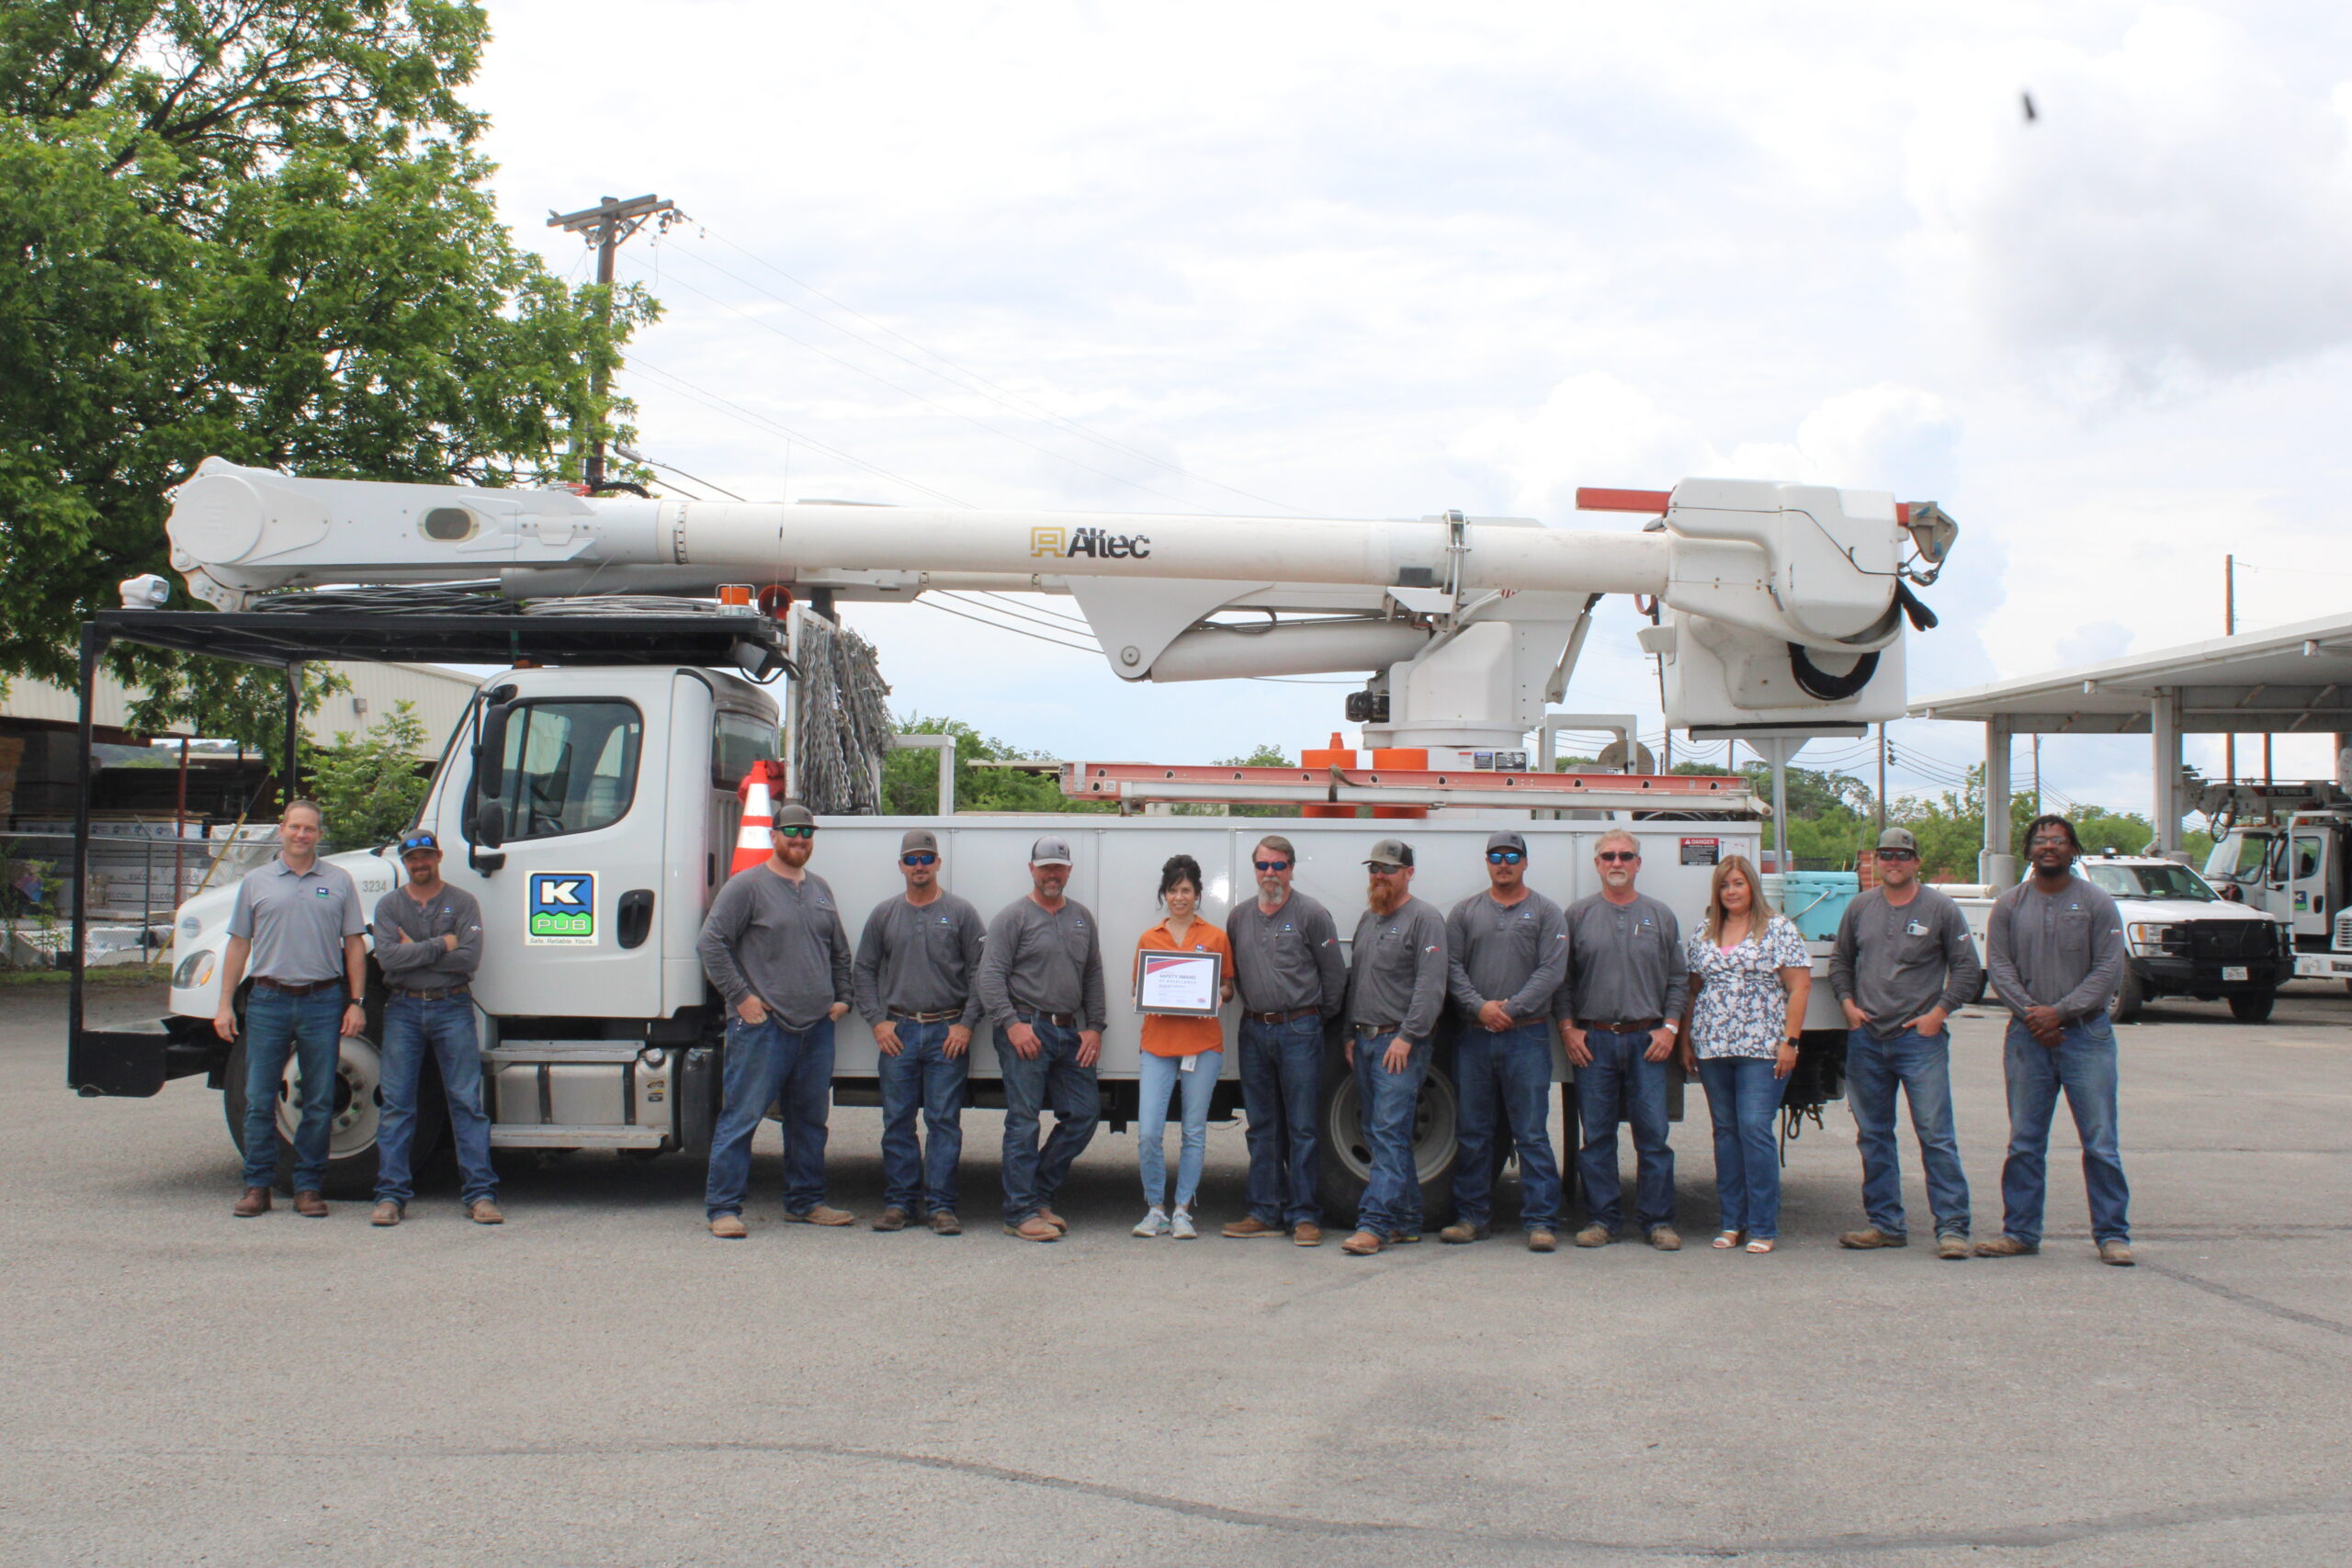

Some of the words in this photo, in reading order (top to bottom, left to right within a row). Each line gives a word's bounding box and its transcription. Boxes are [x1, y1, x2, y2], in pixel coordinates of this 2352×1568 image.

[1067, 527, 1150, 559] Altec
[363, 880, 387, 893] 3234
[540, 879, 586, 906] K
[537, 919, 586, 931] PUB
[575, 937, 594, 945] Yours.
